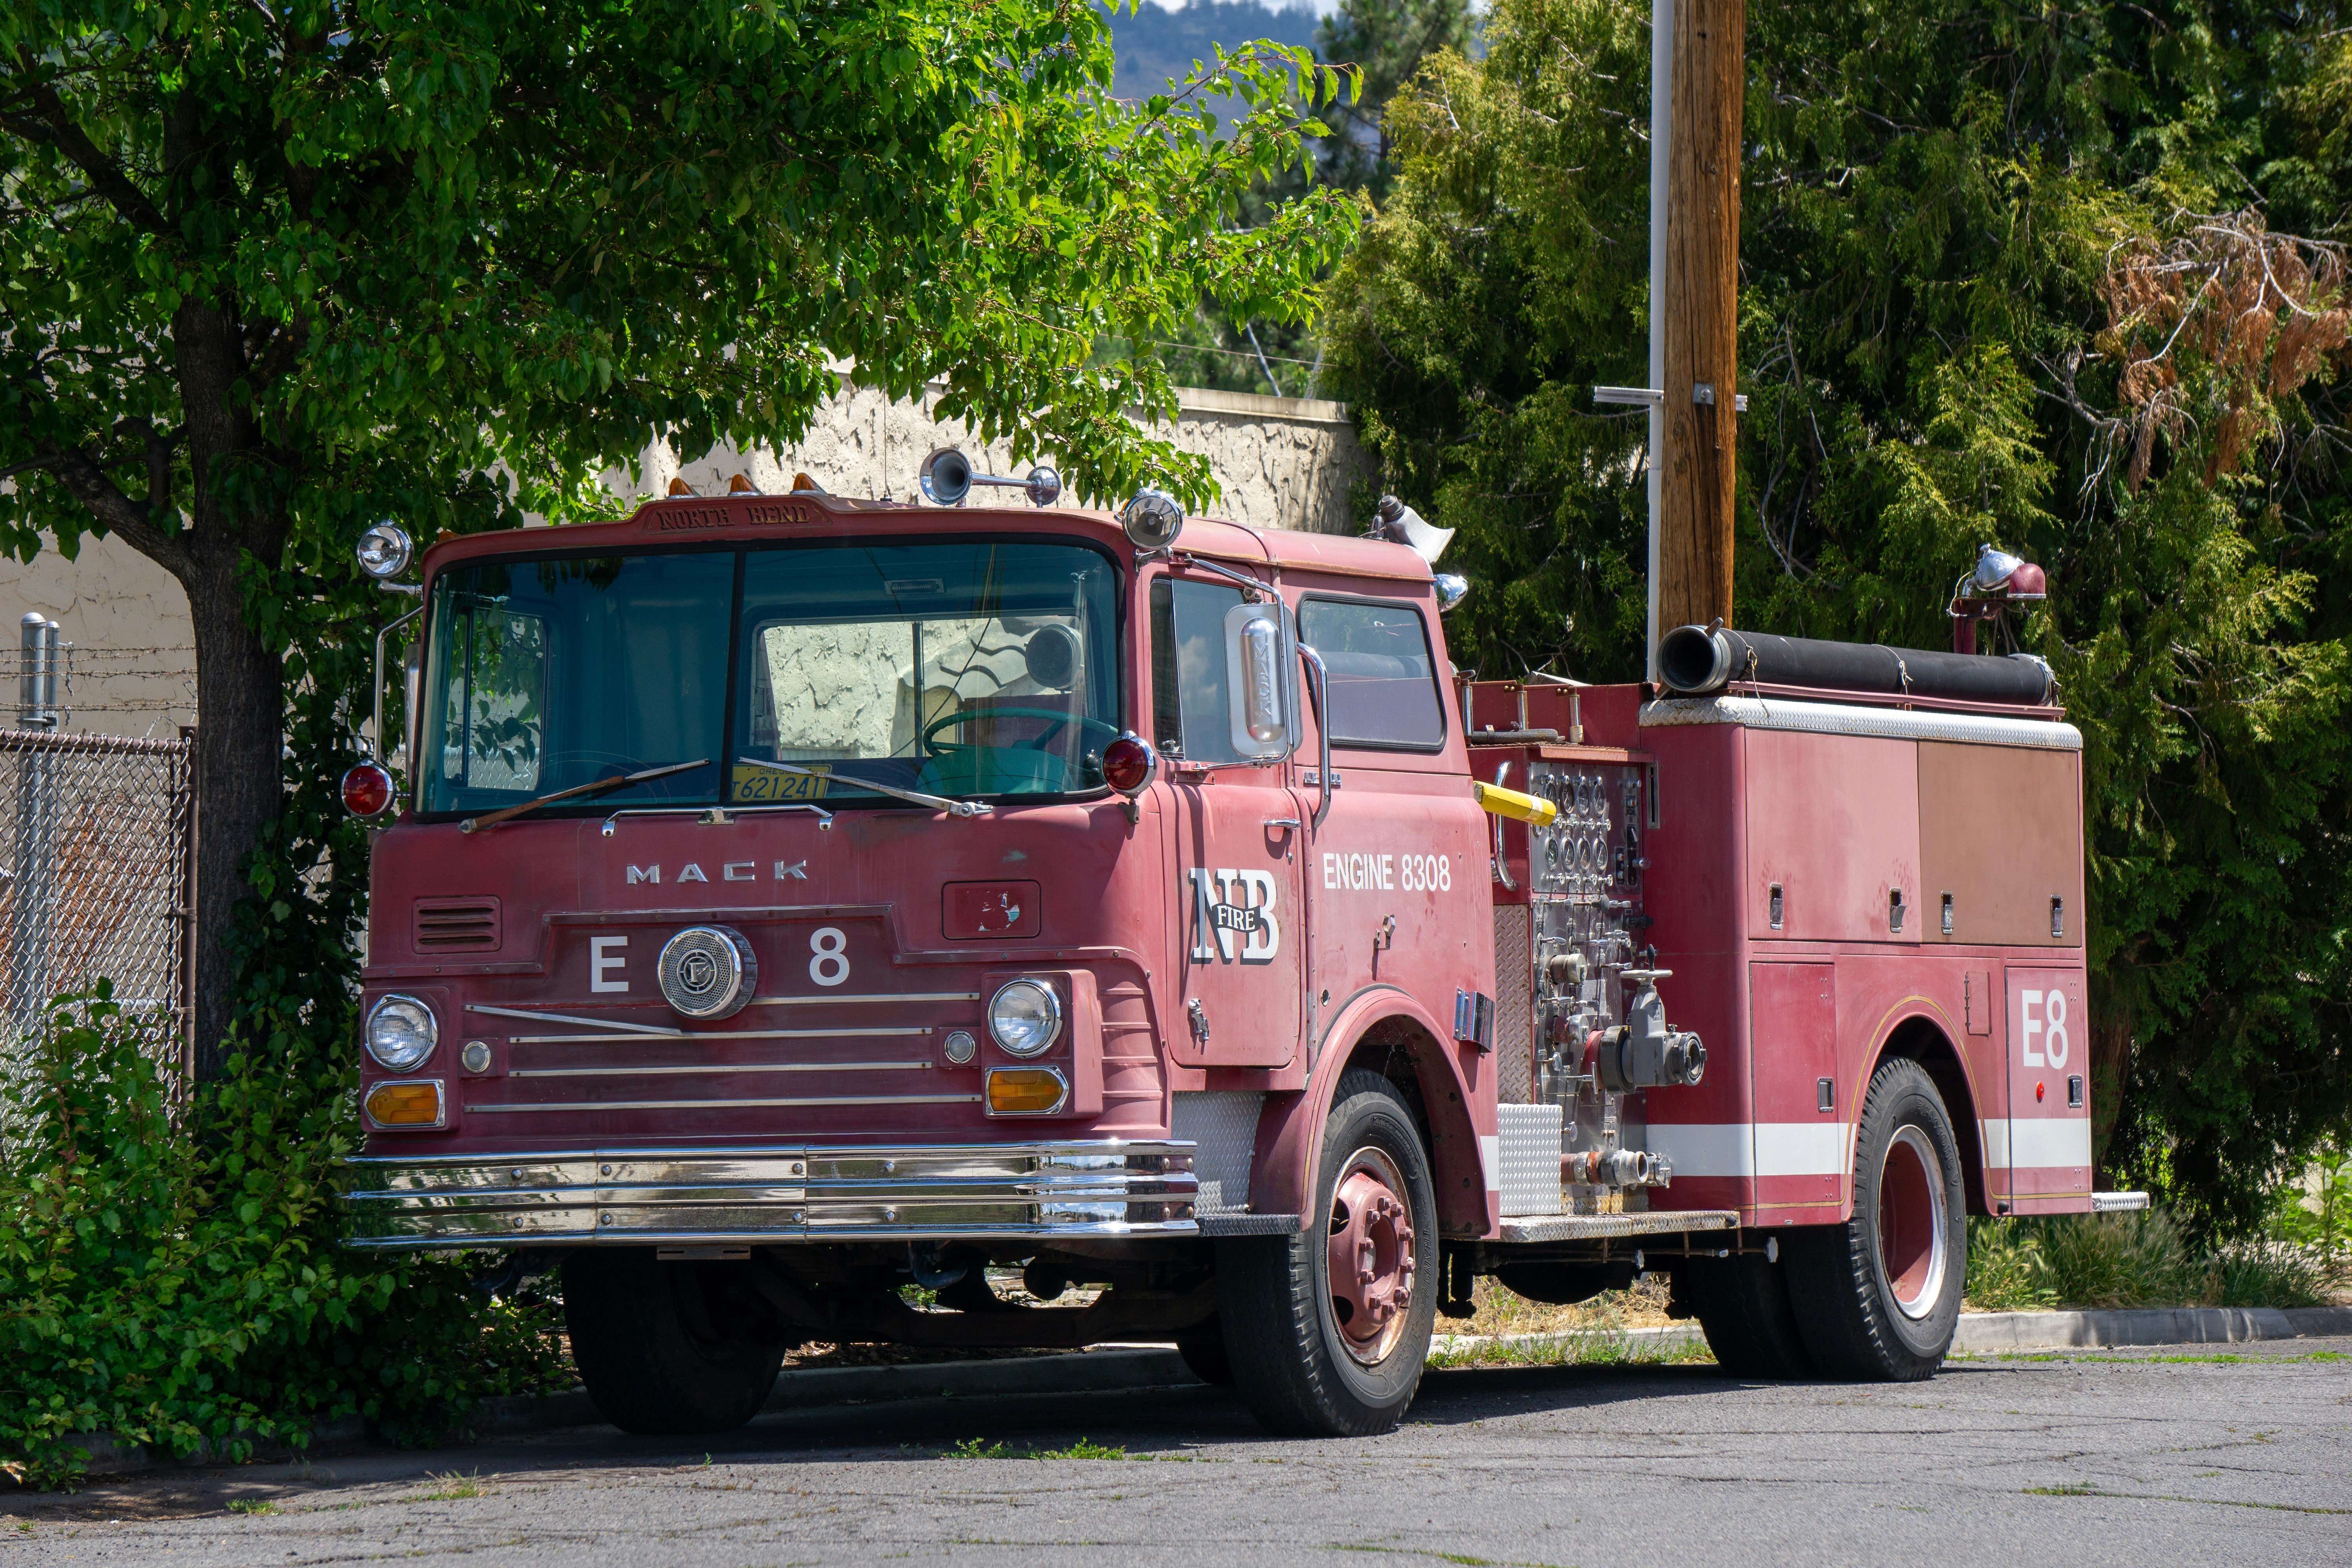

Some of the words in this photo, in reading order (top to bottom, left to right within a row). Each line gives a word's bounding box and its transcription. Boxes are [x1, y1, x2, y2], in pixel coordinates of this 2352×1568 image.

[657, 507, 735, 530] NORTH
[747, 505, 810, 525] BEND
[1253, 643, 1272, 717] MACK
[627, 859, 808, 885] MACK
[1323, 853, 1394, 890] ENGINE
[1402, 854, 1451, 891] 8308
[1217, 905, 1255, 931] FIRE
[591, 936, 629, 993] E
[809, 927, 850, 986] 8
[2022, 989, 2069, 1069] E8
